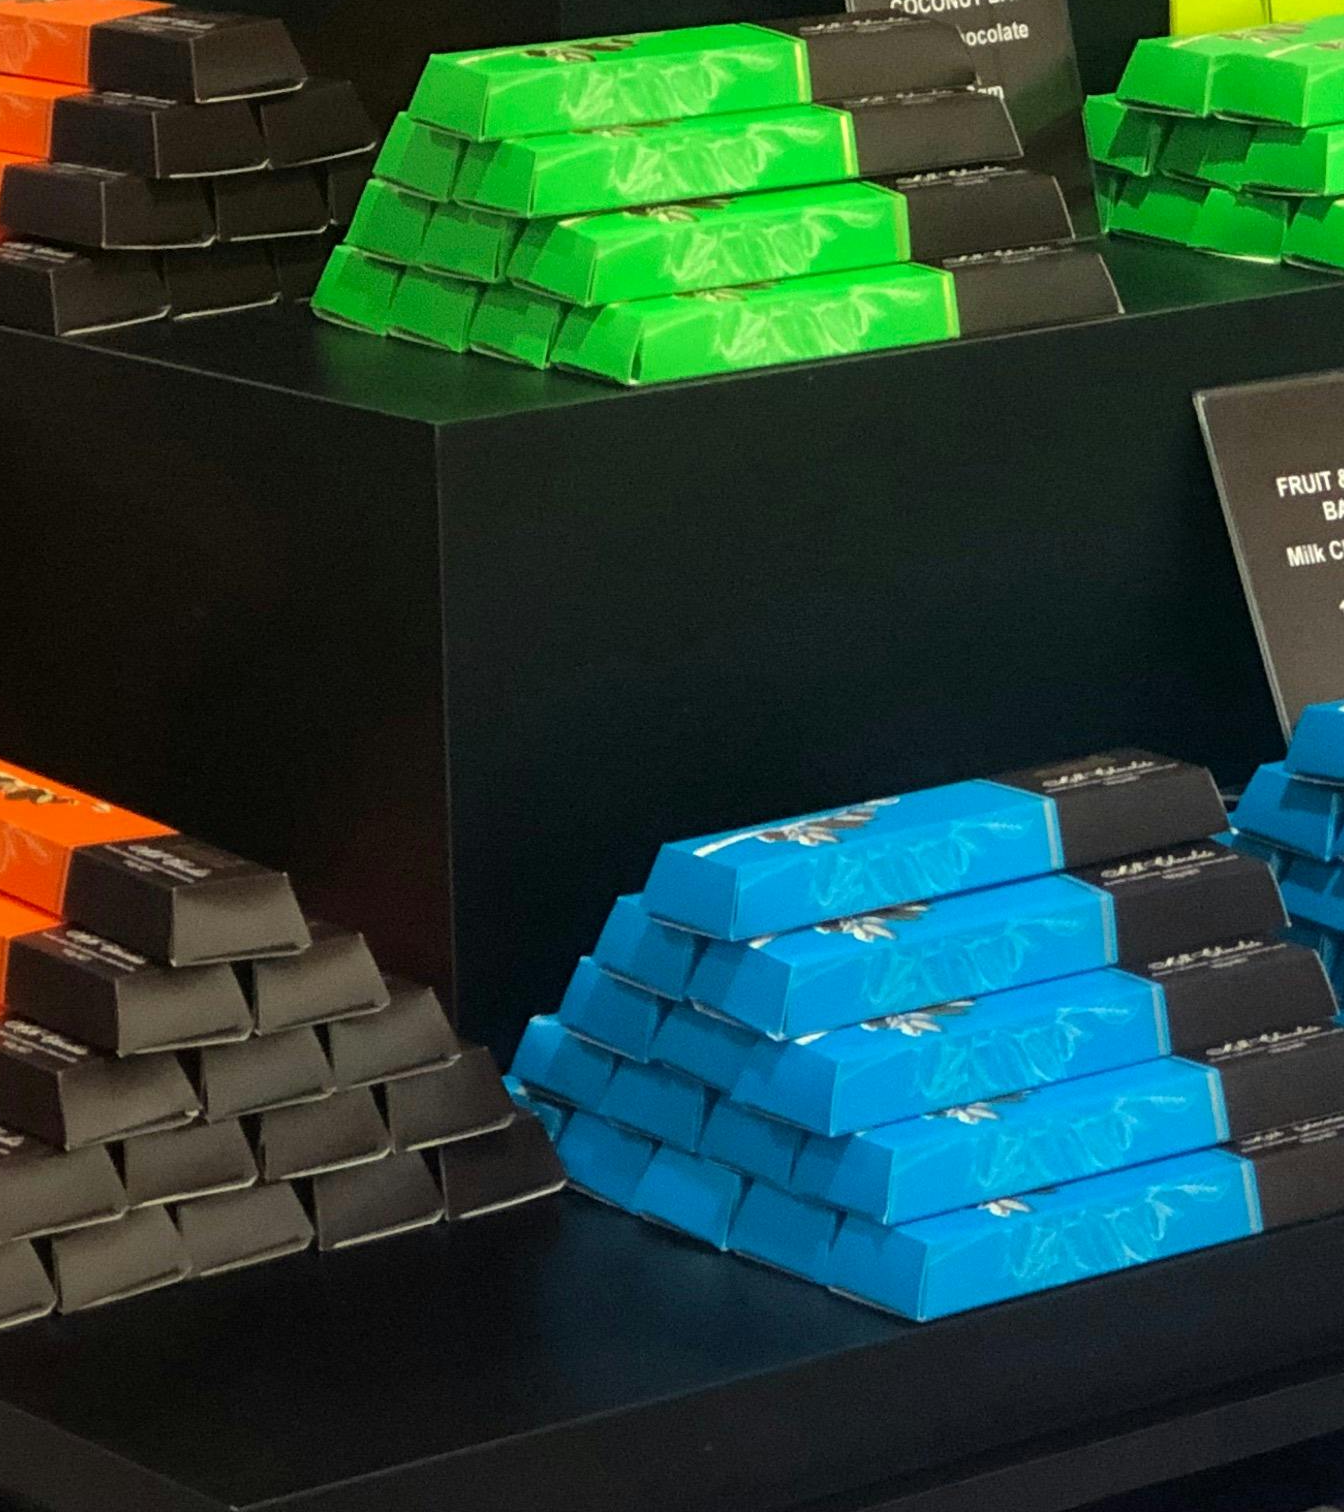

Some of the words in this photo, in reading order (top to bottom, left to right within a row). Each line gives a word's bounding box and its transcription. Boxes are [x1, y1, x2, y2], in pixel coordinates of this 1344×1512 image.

[962, 21, 1029, 47] ocolate
[1276, 470, 1332, 498] FRUIT
[1286, 543, 1326, 567] Milk
